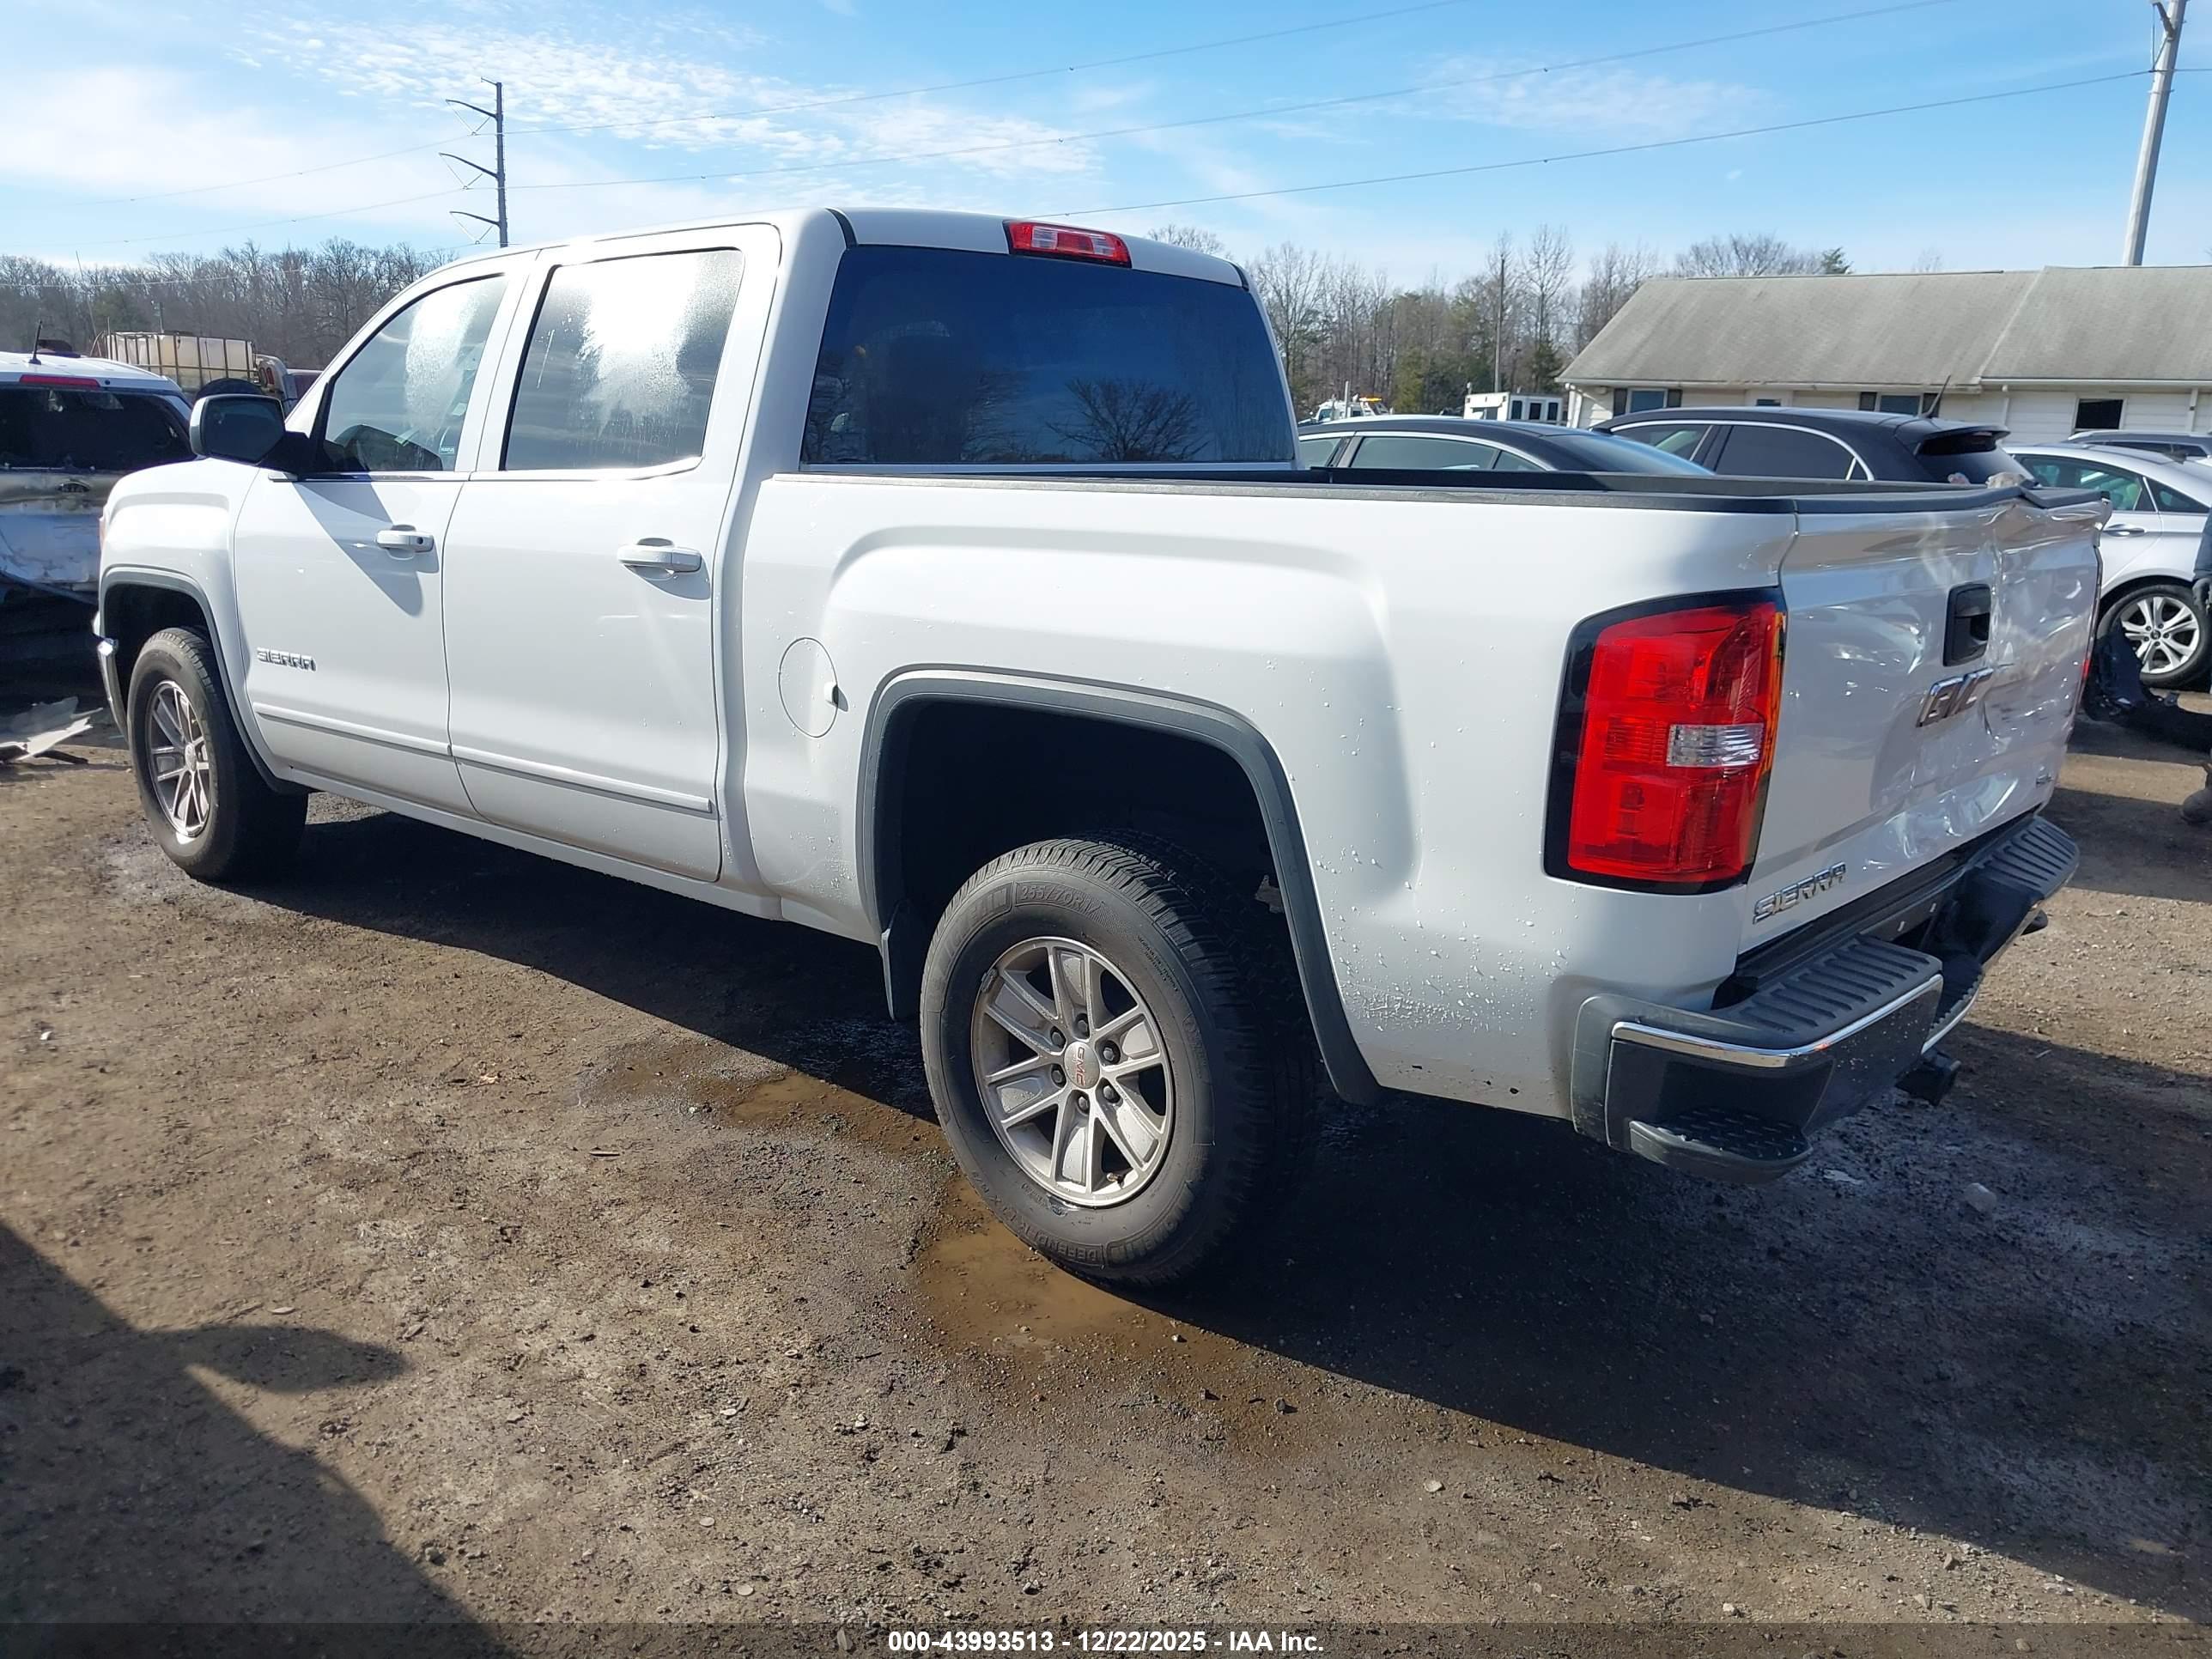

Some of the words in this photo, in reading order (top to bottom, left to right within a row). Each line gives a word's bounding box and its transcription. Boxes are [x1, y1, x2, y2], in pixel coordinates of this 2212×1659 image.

[257, 647, 317, 672] SIERRA
[1915, 667, 1994, 728] GC
[1753, 861, 1847, 925] SIERRA
[1076, 1046, 1086, 1086] GMC
